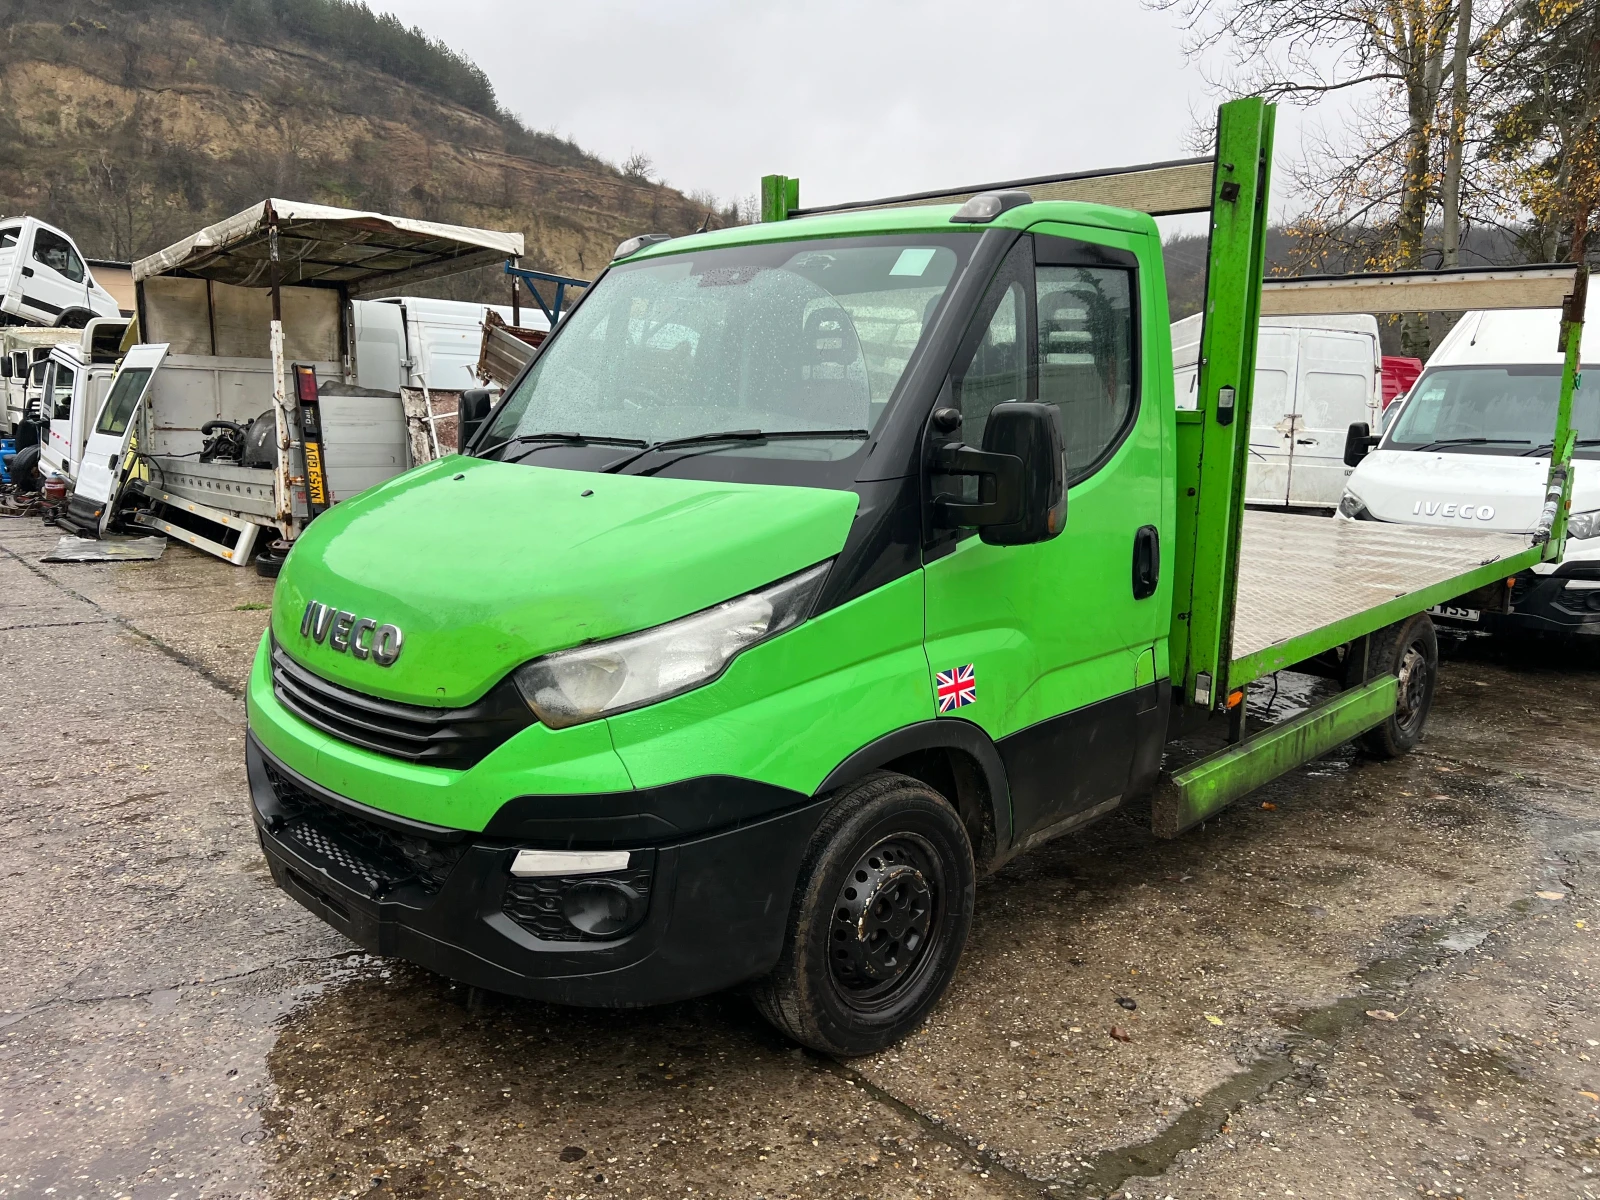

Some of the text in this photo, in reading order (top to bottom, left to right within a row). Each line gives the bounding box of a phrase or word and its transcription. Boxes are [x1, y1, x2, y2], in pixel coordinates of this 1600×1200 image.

[305, 445, 322, 500] NX53 GDV
[1412, 500, 1496, 521] IVECO
[300, 600, 403, 668] IVECO
